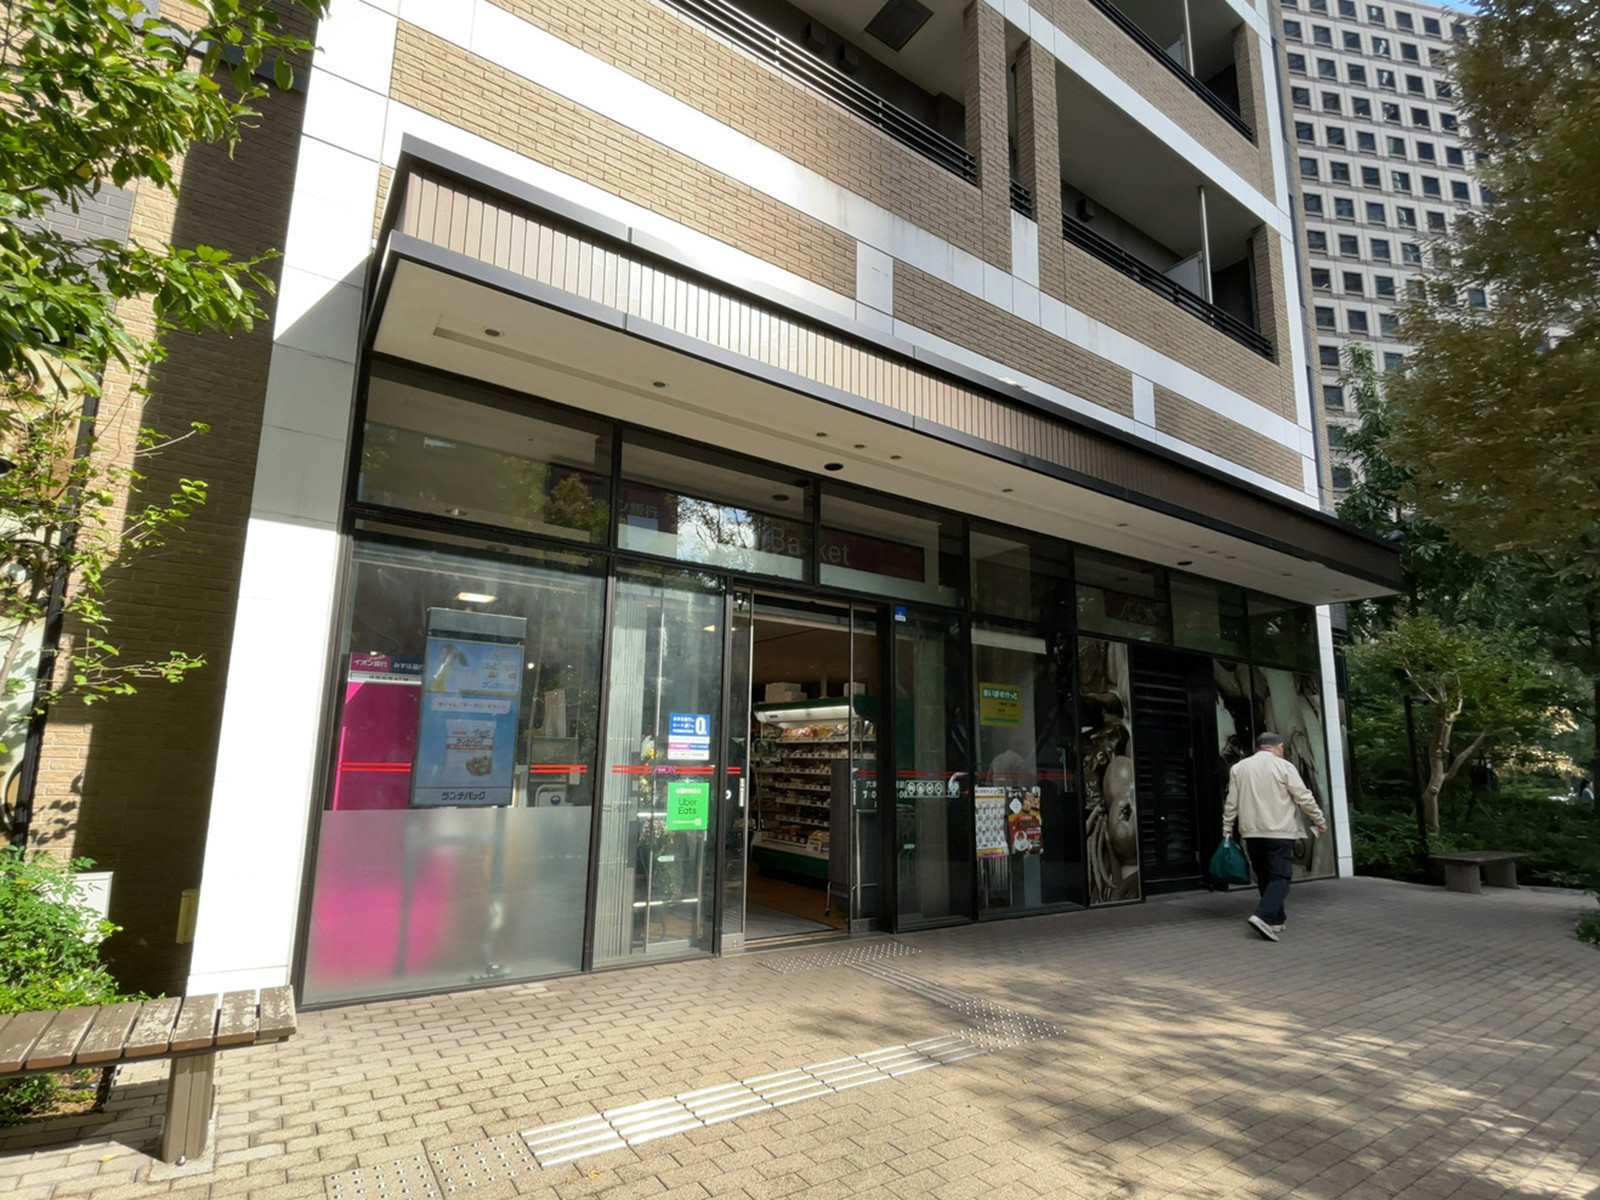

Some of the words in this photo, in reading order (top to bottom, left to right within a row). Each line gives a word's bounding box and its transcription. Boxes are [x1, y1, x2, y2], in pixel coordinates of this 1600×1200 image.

[770, 526, 850, 566] Baket
[441, 791, 486, 801] ランチパック
[678, 798, 697, 806] Uber
[678, 806, 697, 815] Eats
